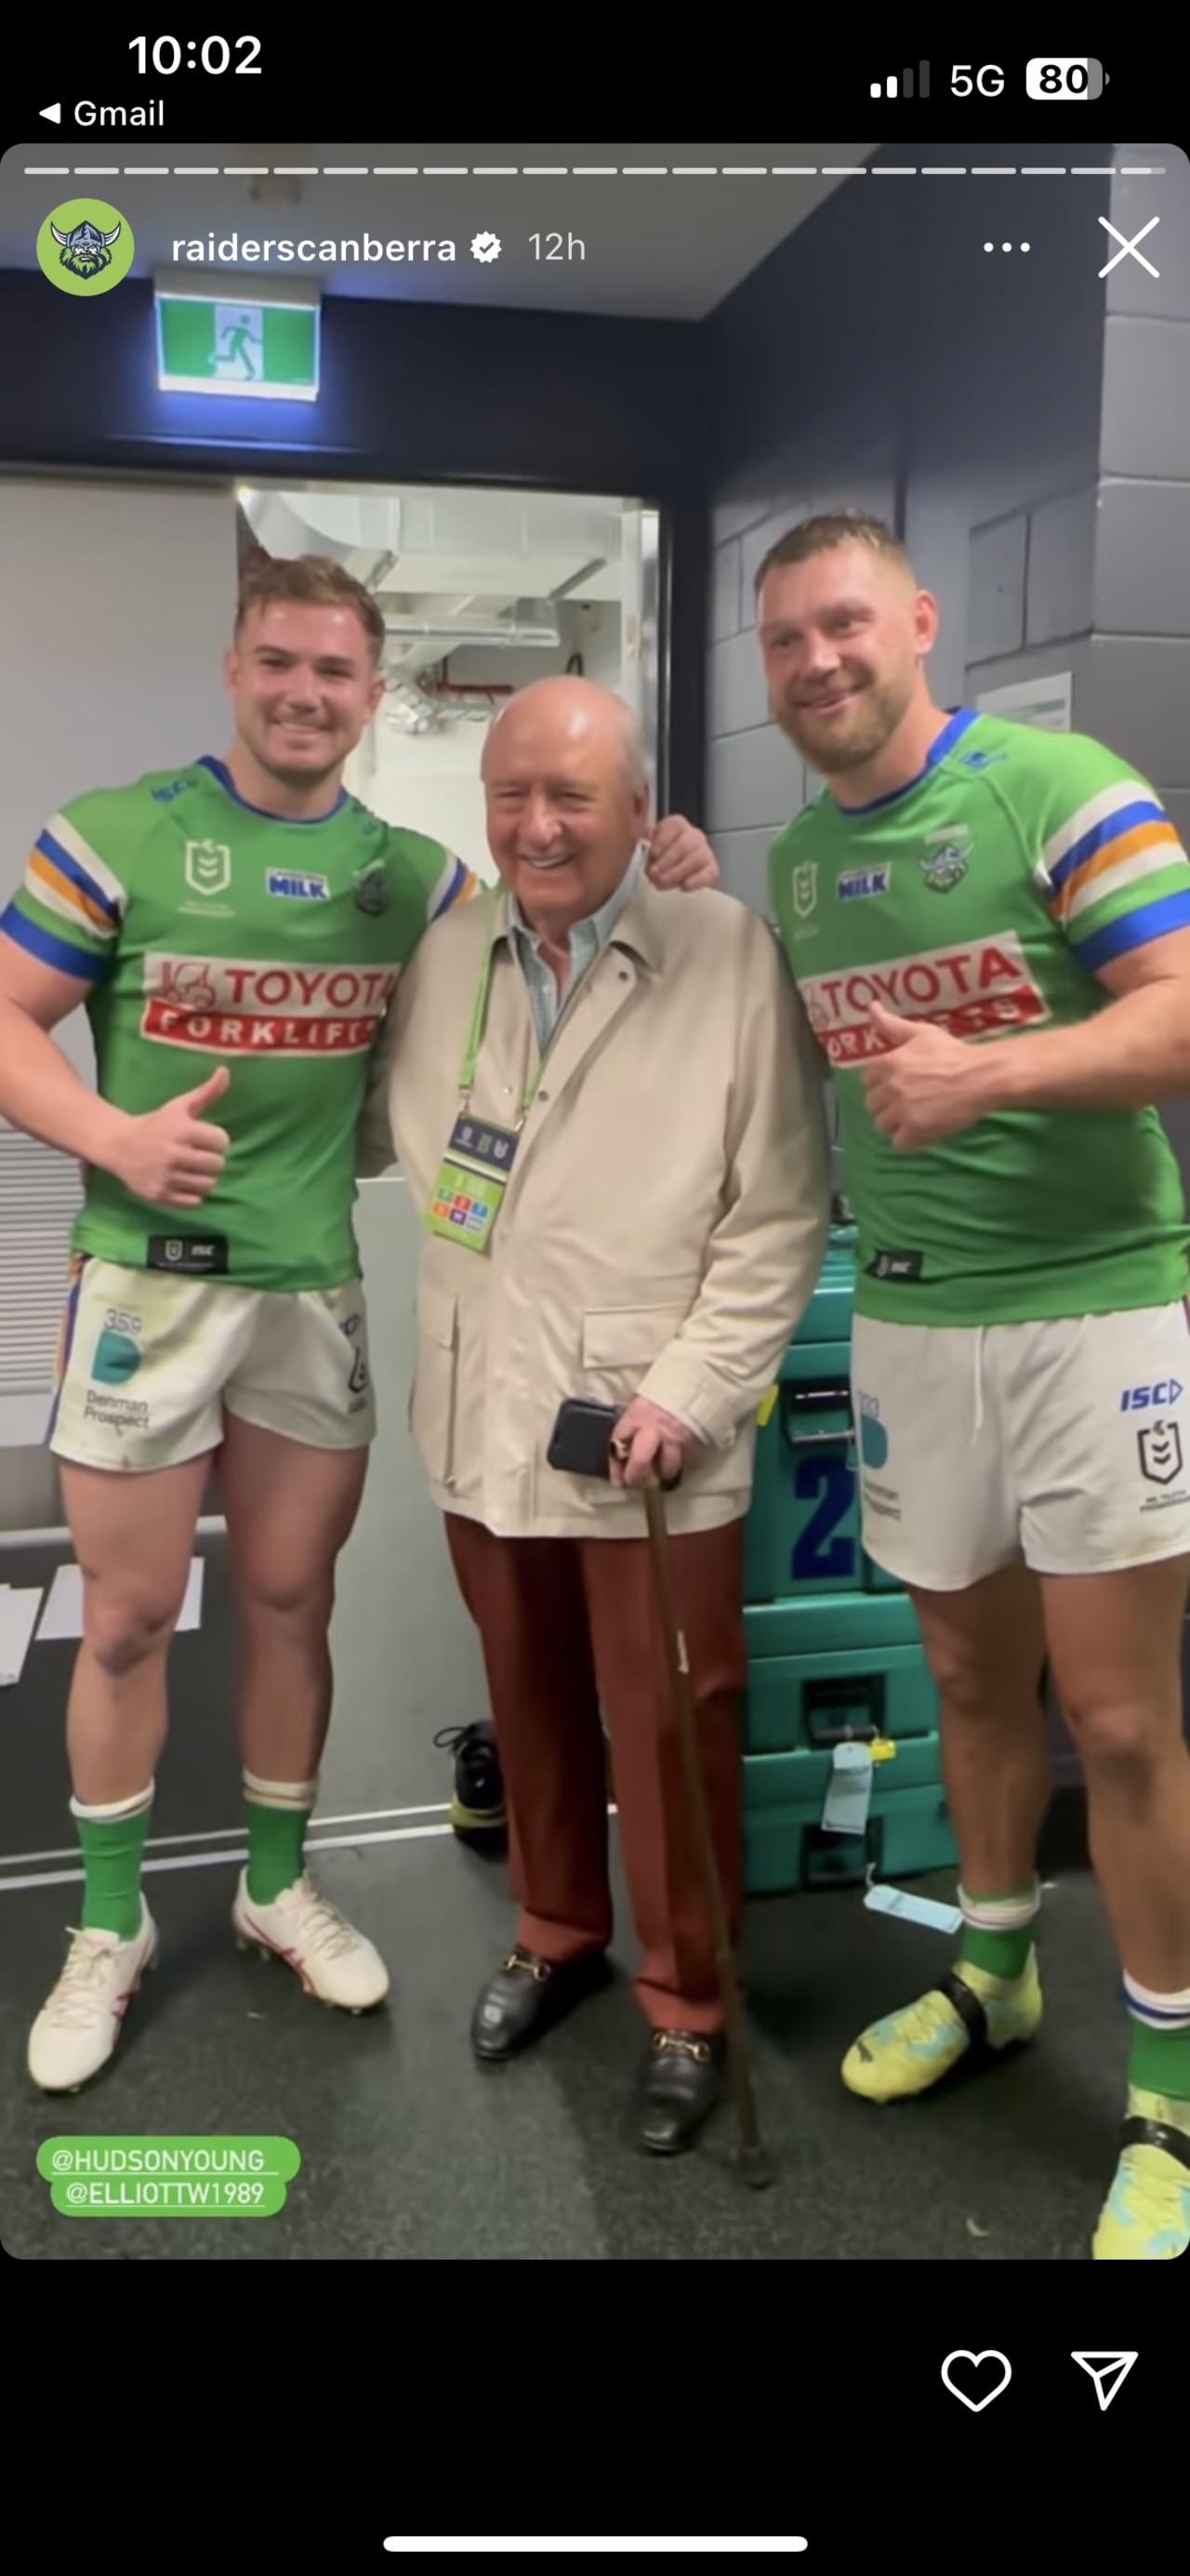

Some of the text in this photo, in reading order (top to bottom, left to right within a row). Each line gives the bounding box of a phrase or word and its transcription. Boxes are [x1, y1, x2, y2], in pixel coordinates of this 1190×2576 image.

[270, 875, 325, 899] MILK
[839, 873, 886, 900] MILK
[820, 946, 1024, 1018] TOYOTA
[86, 1388, 149, 1413] Denman
[1120, 1382, 1169, 1412] ISC
[84, 1404, 150, 1430] Prospect
[792, 1454, 855, 1580] 2
